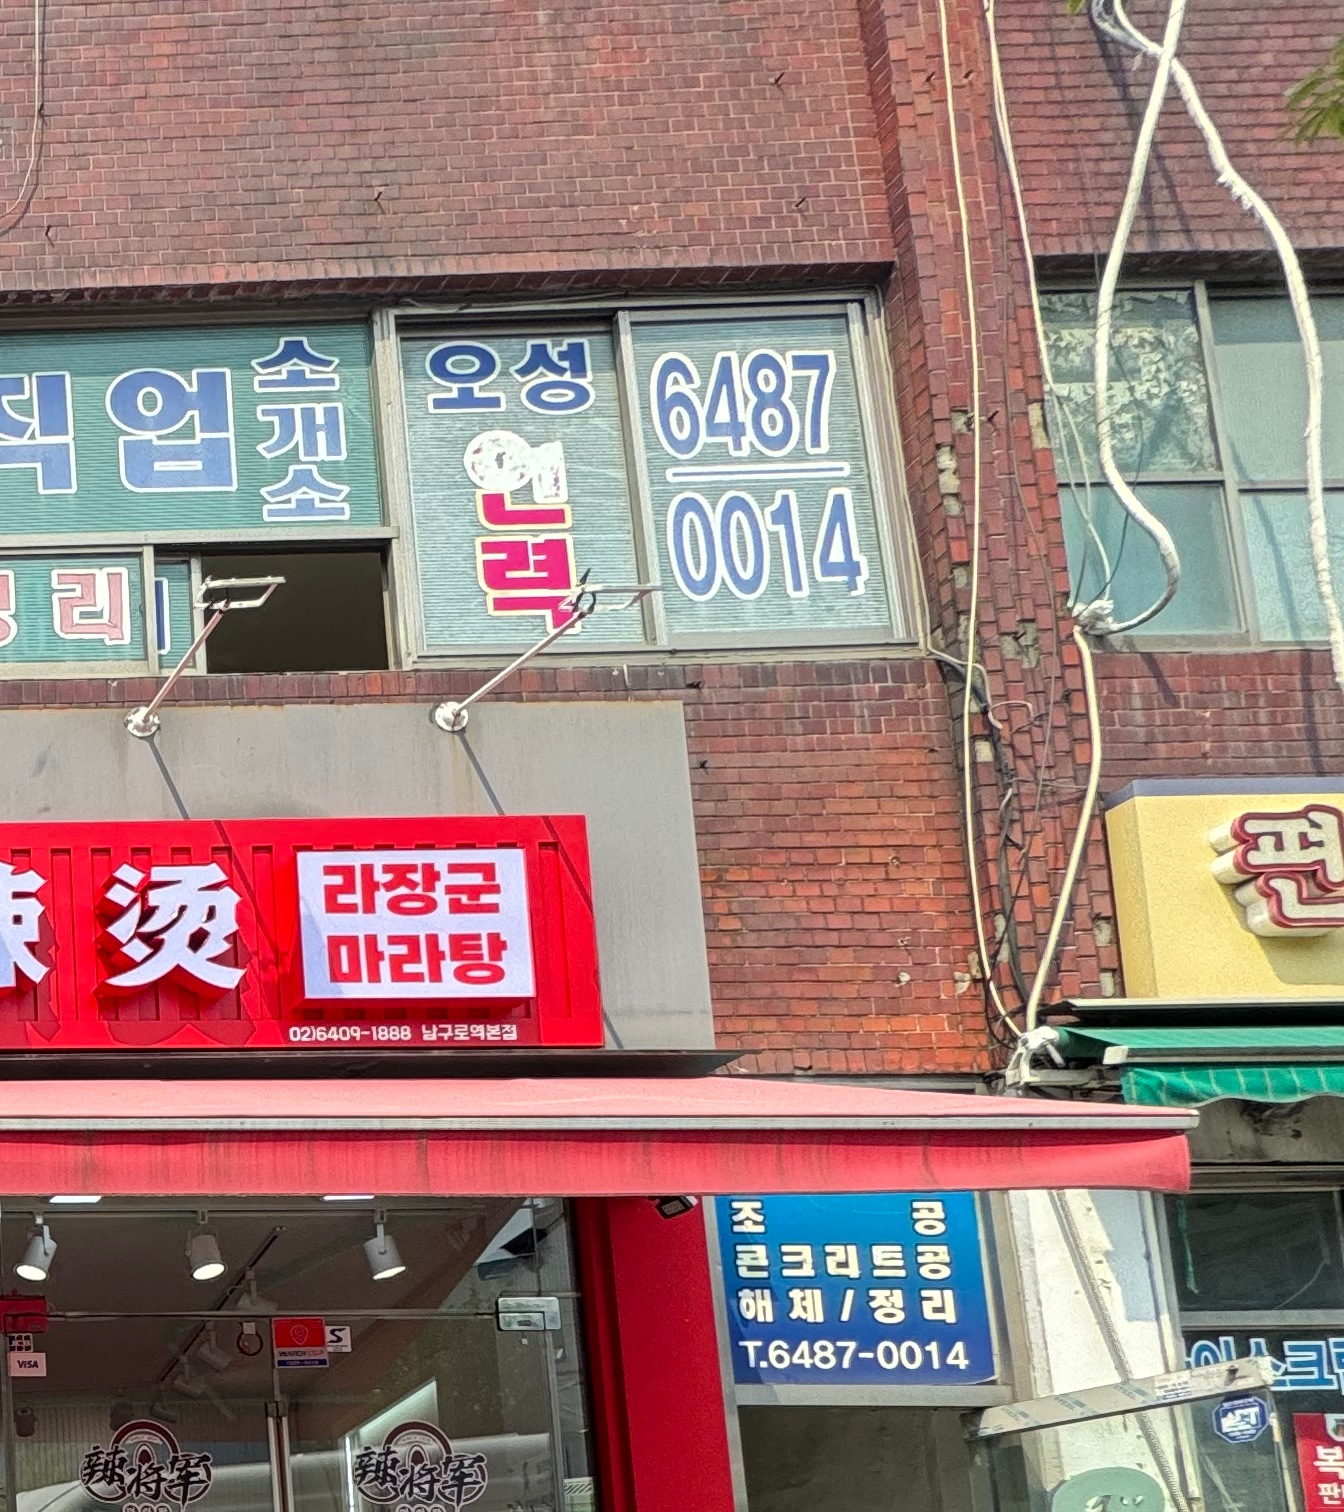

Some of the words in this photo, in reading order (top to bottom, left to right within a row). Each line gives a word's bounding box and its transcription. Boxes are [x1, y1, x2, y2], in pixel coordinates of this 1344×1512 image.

[425, 338, 594, 416] 오성
[650, 347, 839, 460] 6487
[251, 336, 351, 522] 소개소
[666, 485, 869, 600] 0014
[322, 861, 502, 918] 라장군
[328, 931, 508, 986] 마라탕
[288, 1025, 412, 1042] 02)6409-1888
[421, 1023, 518, 1041] 남구로역본점
[734, 1244, 951, 1281] 콘크리트공
[737, 1288, 957, 1324] 해체/정리
[17, 1360, 39, 1369] VISA
[738, 1340, 970, 1370] T.6487-0014
